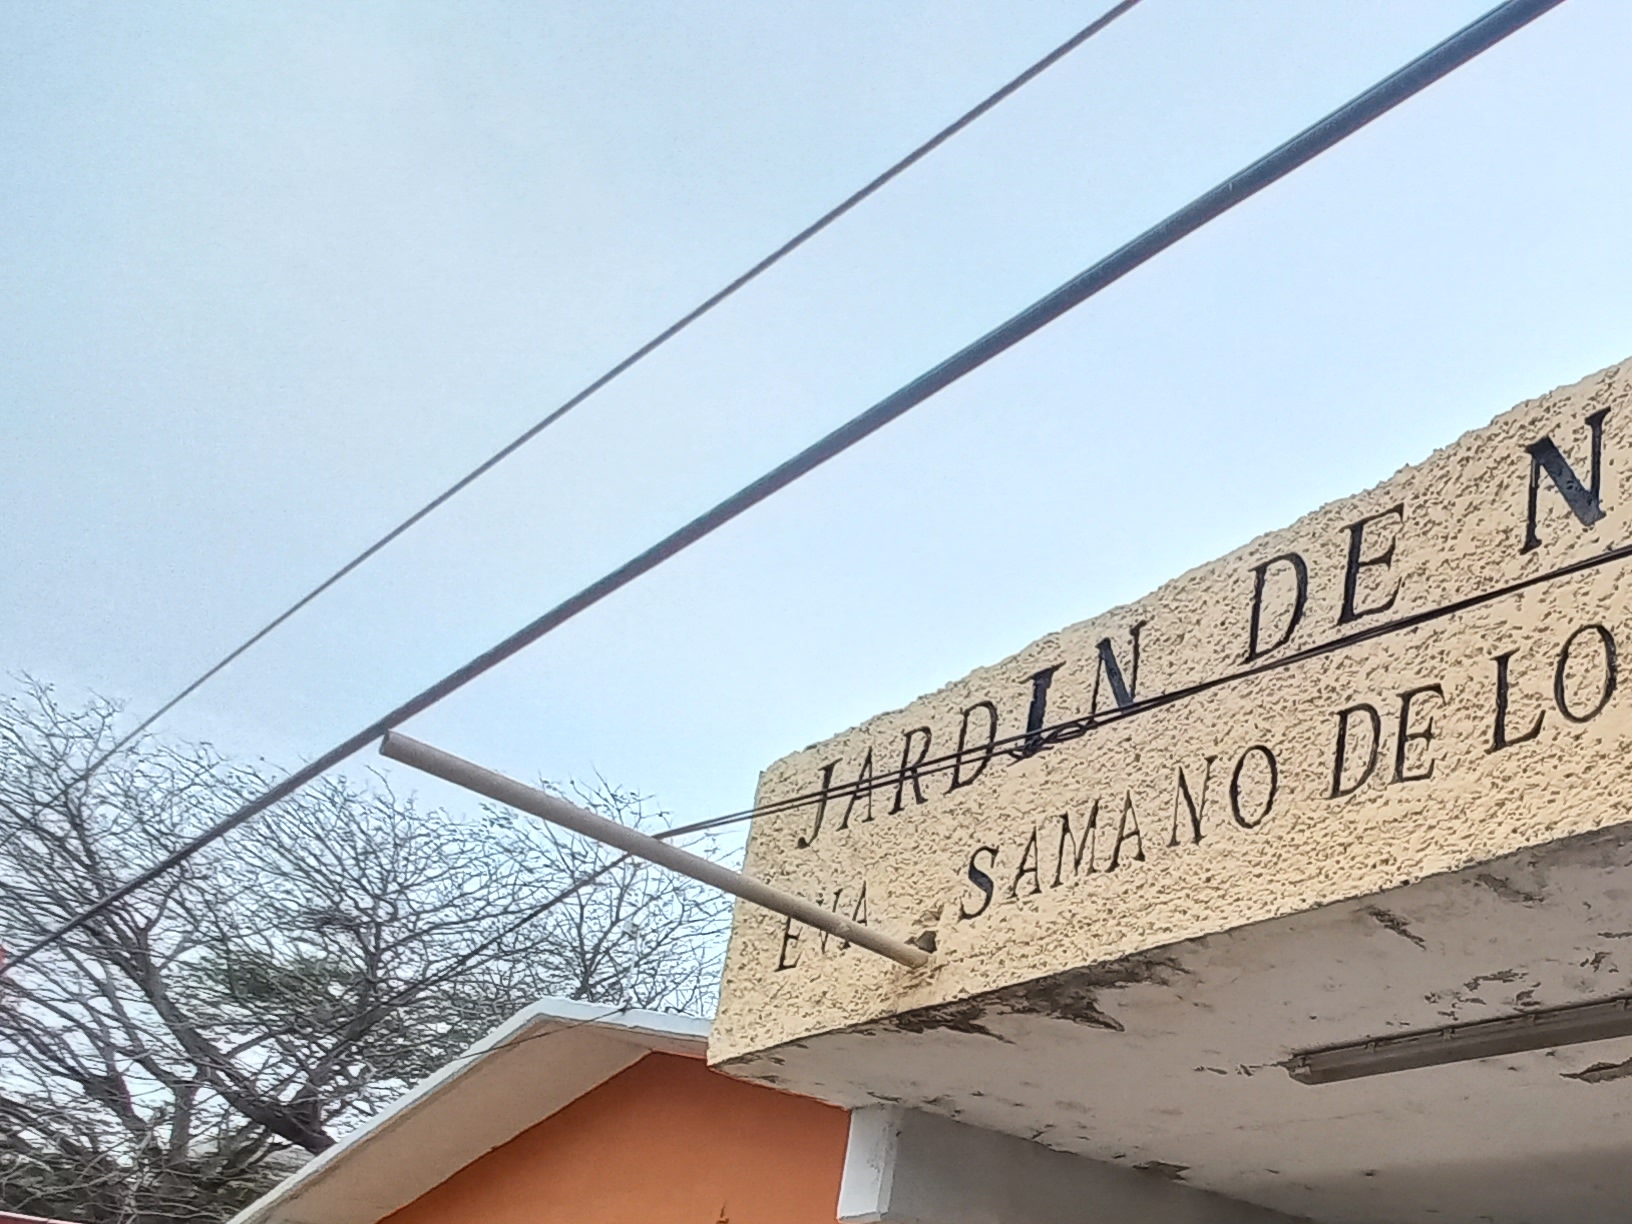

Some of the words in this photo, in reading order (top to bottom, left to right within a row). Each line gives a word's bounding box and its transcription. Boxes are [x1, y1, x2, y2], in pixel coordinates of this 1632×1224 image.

[798, 619, 1148, 849] JARDIN
[1243, 502, 1405, 664] DE
[957, 743, 1279, 921] SAMANO
[1325, 682, 1445, 800] DE
